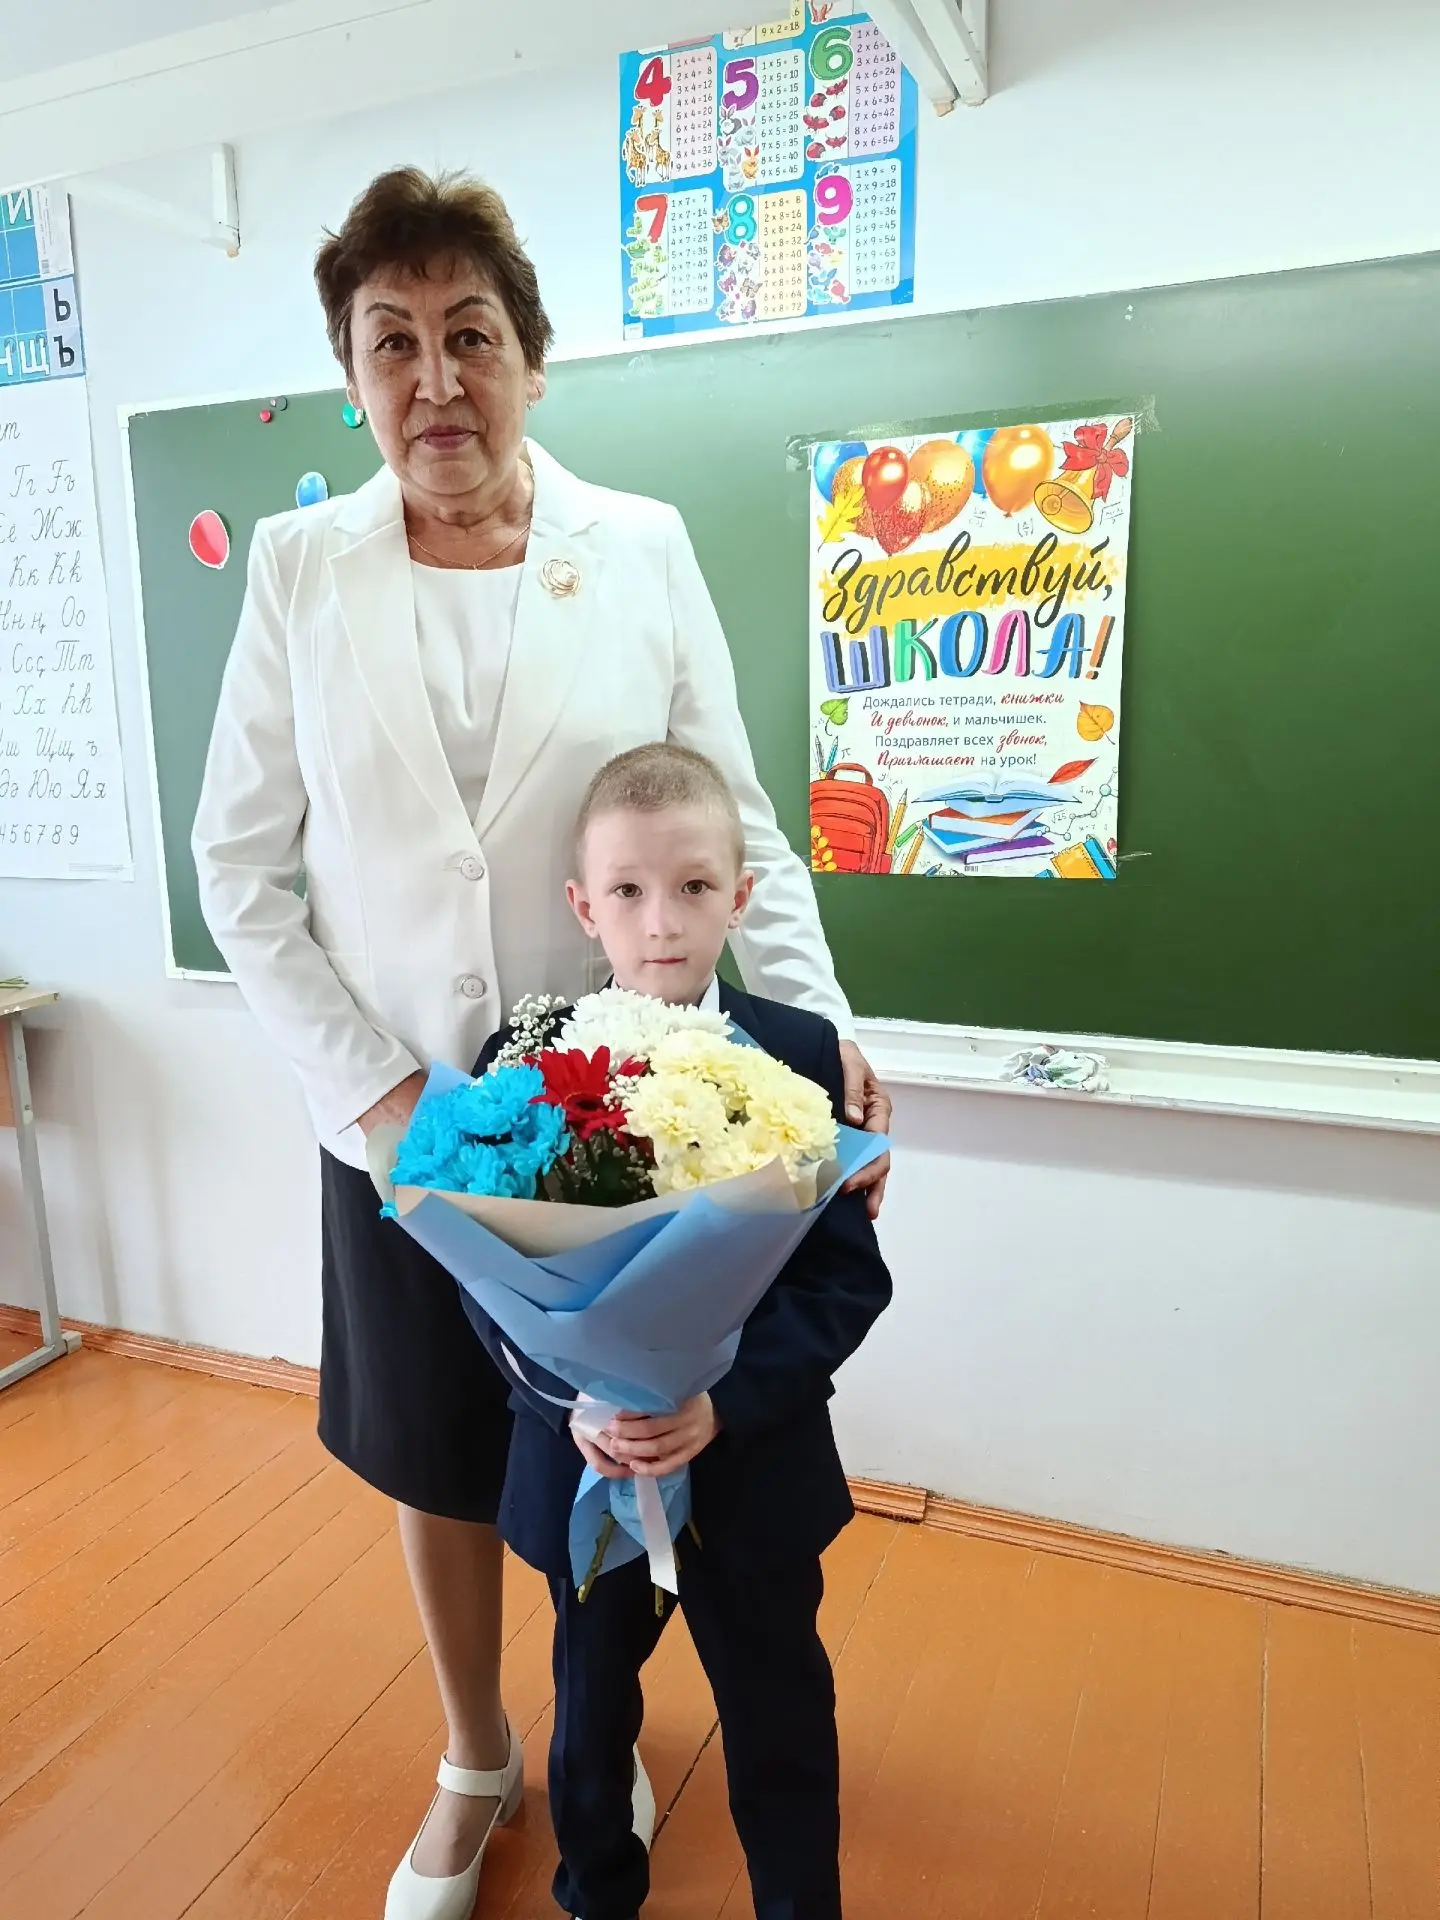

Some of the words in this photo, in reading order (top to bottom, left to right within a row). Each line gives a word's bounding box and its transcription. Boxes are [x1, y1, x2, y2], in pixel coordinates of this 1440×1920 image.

[761, 27, 767, 36] 9
[777, 25, 781, 33] 2
[790, 21, 800, 31] 18
[677, 58, 681, 68] 1
[690, 56, 696, 64] 4
[706, 52, 712, 62] 4
[811, 27, 853, 81] 6
[856, 57, 863, 67] 3
[873, 54, 879, 64] 6
[884, 52, 896, 63] 18
[761, 61, 767, 70] 1
[776, 58, 781, 68] 5
[793, 55, 799, 64] 5
[677, 72, 682, 82] 2
[691, 68, 696, 78] 4
[707, 66, 712, 75] 8
[762, 75, 767, 84] 2
[776, 72, 782, 81] 5
[789, 69, 799, 79] 10
[856, 72, 862, 80] 4
[872, 68, 878, 78] 6
[884, 66, 895, 76] 24
[635, 57, 672, 107] 4
[676, 85, 682, 94] 3
[691, 82, 696, 92] 4
[703, 79, 712, 89] 12
[722, 58, 760, 111] 5
[761, 88, 767, 98] 3
[776, 86, 781, 95] 5
[789, 82, 799, 92] 15
[856, 85, 861, 95] 5
[872, 82, 878, 92] 6
[885, 80, 896, 90] 30
[676, 99, 682, 107] 4
[691, 96, 696, 104] 4
[702, 93, 712, 103] 16
[761, 102, 766, 111] 4
[776, 99, 781, 109] 5
[789, 96, 799, 107] 20
[855, 98, 861, 108] 6
[872, 96, 877, 106] 6
[883, 93, 895, 104] 36
[676, 112, 682, 120] 5
[691, 109, 697, 117] 4
[703, 106, 712, 116] 20
[761, 115, 767, 124] 5
[776, 113, 781, 123] 5
[789, 109, 799, 120] 25
[854, 112, 860, 121] 7
[871, 109, 878, 119] 6
[883, 107, 895, 117] 42
[856, 170, 862, 179] 1
[871, 167, 878, 176] 9
[890, 164, 896, 173] 9
[856, 184, 861, 192] 2
[872, 181, 877, 190] 9
[885, 178, 896, 188] 18
[816, 175, 854, 226] 9
[856, 197, 861, 207] 3
[871, 195, 877, 204] 9
[885, 192, 896, 202] 27
[636, 194, 669, 243] 7
[725, 194, 757, 246] 8
[19, 337, 50, 376] Щ
[31, 506, 82, 541] Жж
[822, 530, 1113, 635] Здравствуй,
[820, 609, 1117, 694] ШКОЛА!
[13, 684, 46, 715] Хх
[862, 696, 935, 710] Дождались
[939, 695, 997, 709] тетради,
[1000, 692, 1065, 705] книжки
[870, 710, 884, 727] И
[884, 710, 949, 735] девчонок,
[952, 716, 961, 726] и
[964, 713, 1047, 726] мальчишек.
[875, 735, 960, 749] Поздравляет
[963, 734, 994, 746] всех
[996, 728, 1048, 753] звонок,
[877, 749, 976, 770] Приглашает
[980, 757, 996, 766] на
[999, 753, 1037, 770] урок!
